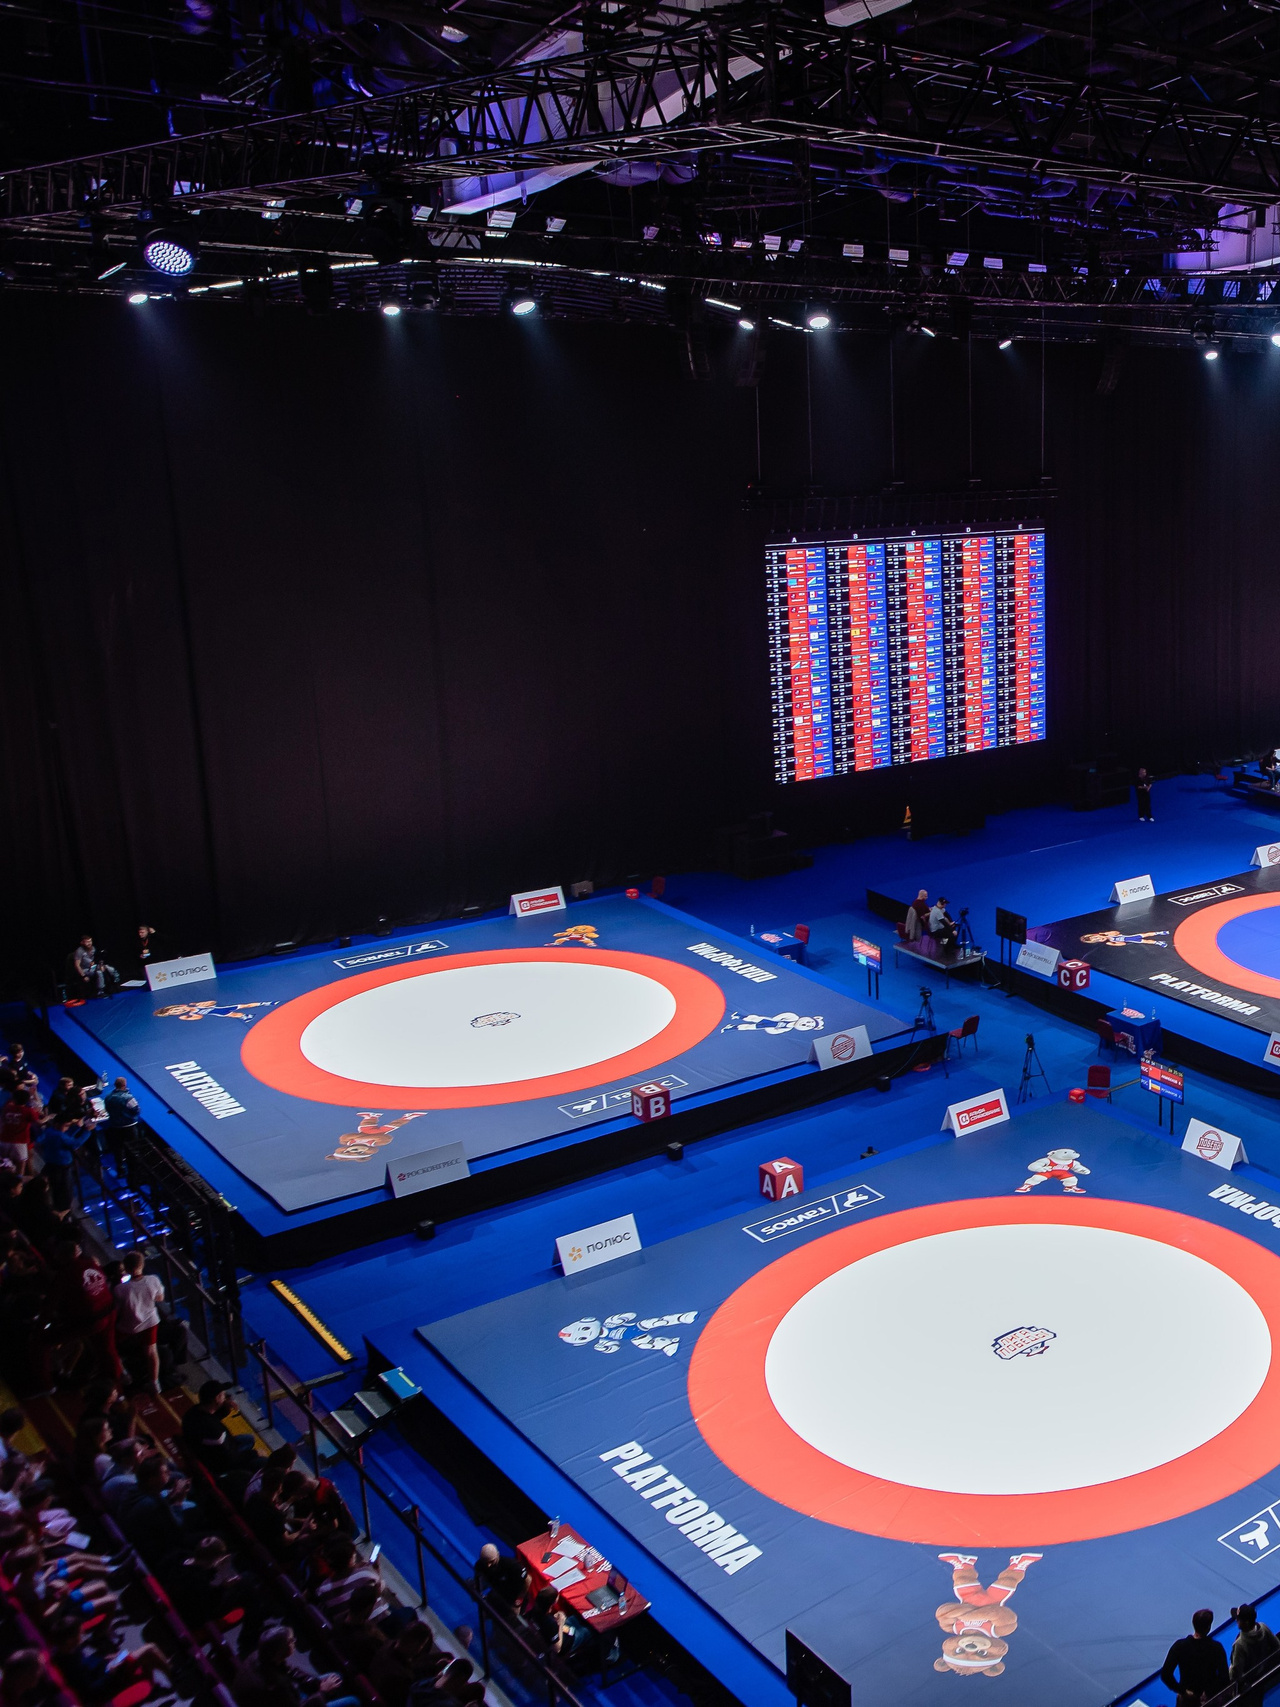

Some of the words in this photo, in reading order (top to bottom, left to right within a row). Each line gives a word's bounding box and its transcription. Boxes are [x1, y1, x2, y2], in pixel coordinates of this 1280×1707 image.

[171, 965, 208, 978] ПОЛЮС
[686, 942, 778, 983] ПЛАТФОРМА
[1060, 969, 1070, 986] C
[1075, 969, 1087, 987] C
[1149, 973, 1262, 1016] PLATFORMA
[165, 1060, 247, 1120] PLATFORMA
[633, 1094, 643, 1117] B
[649, 1096, 666, 1118] B
[407, 1158, 461, 1178] РОСКОНГРЕСС
[772, 1161, 795, 1173] A
[762, 1174, 774, 1198] A
[781, 1174, 799, 1199] A
[586, 1231, 632, 1254] ПОЛЮС
[599, 1440, 763, 1576] PLATFORMA
